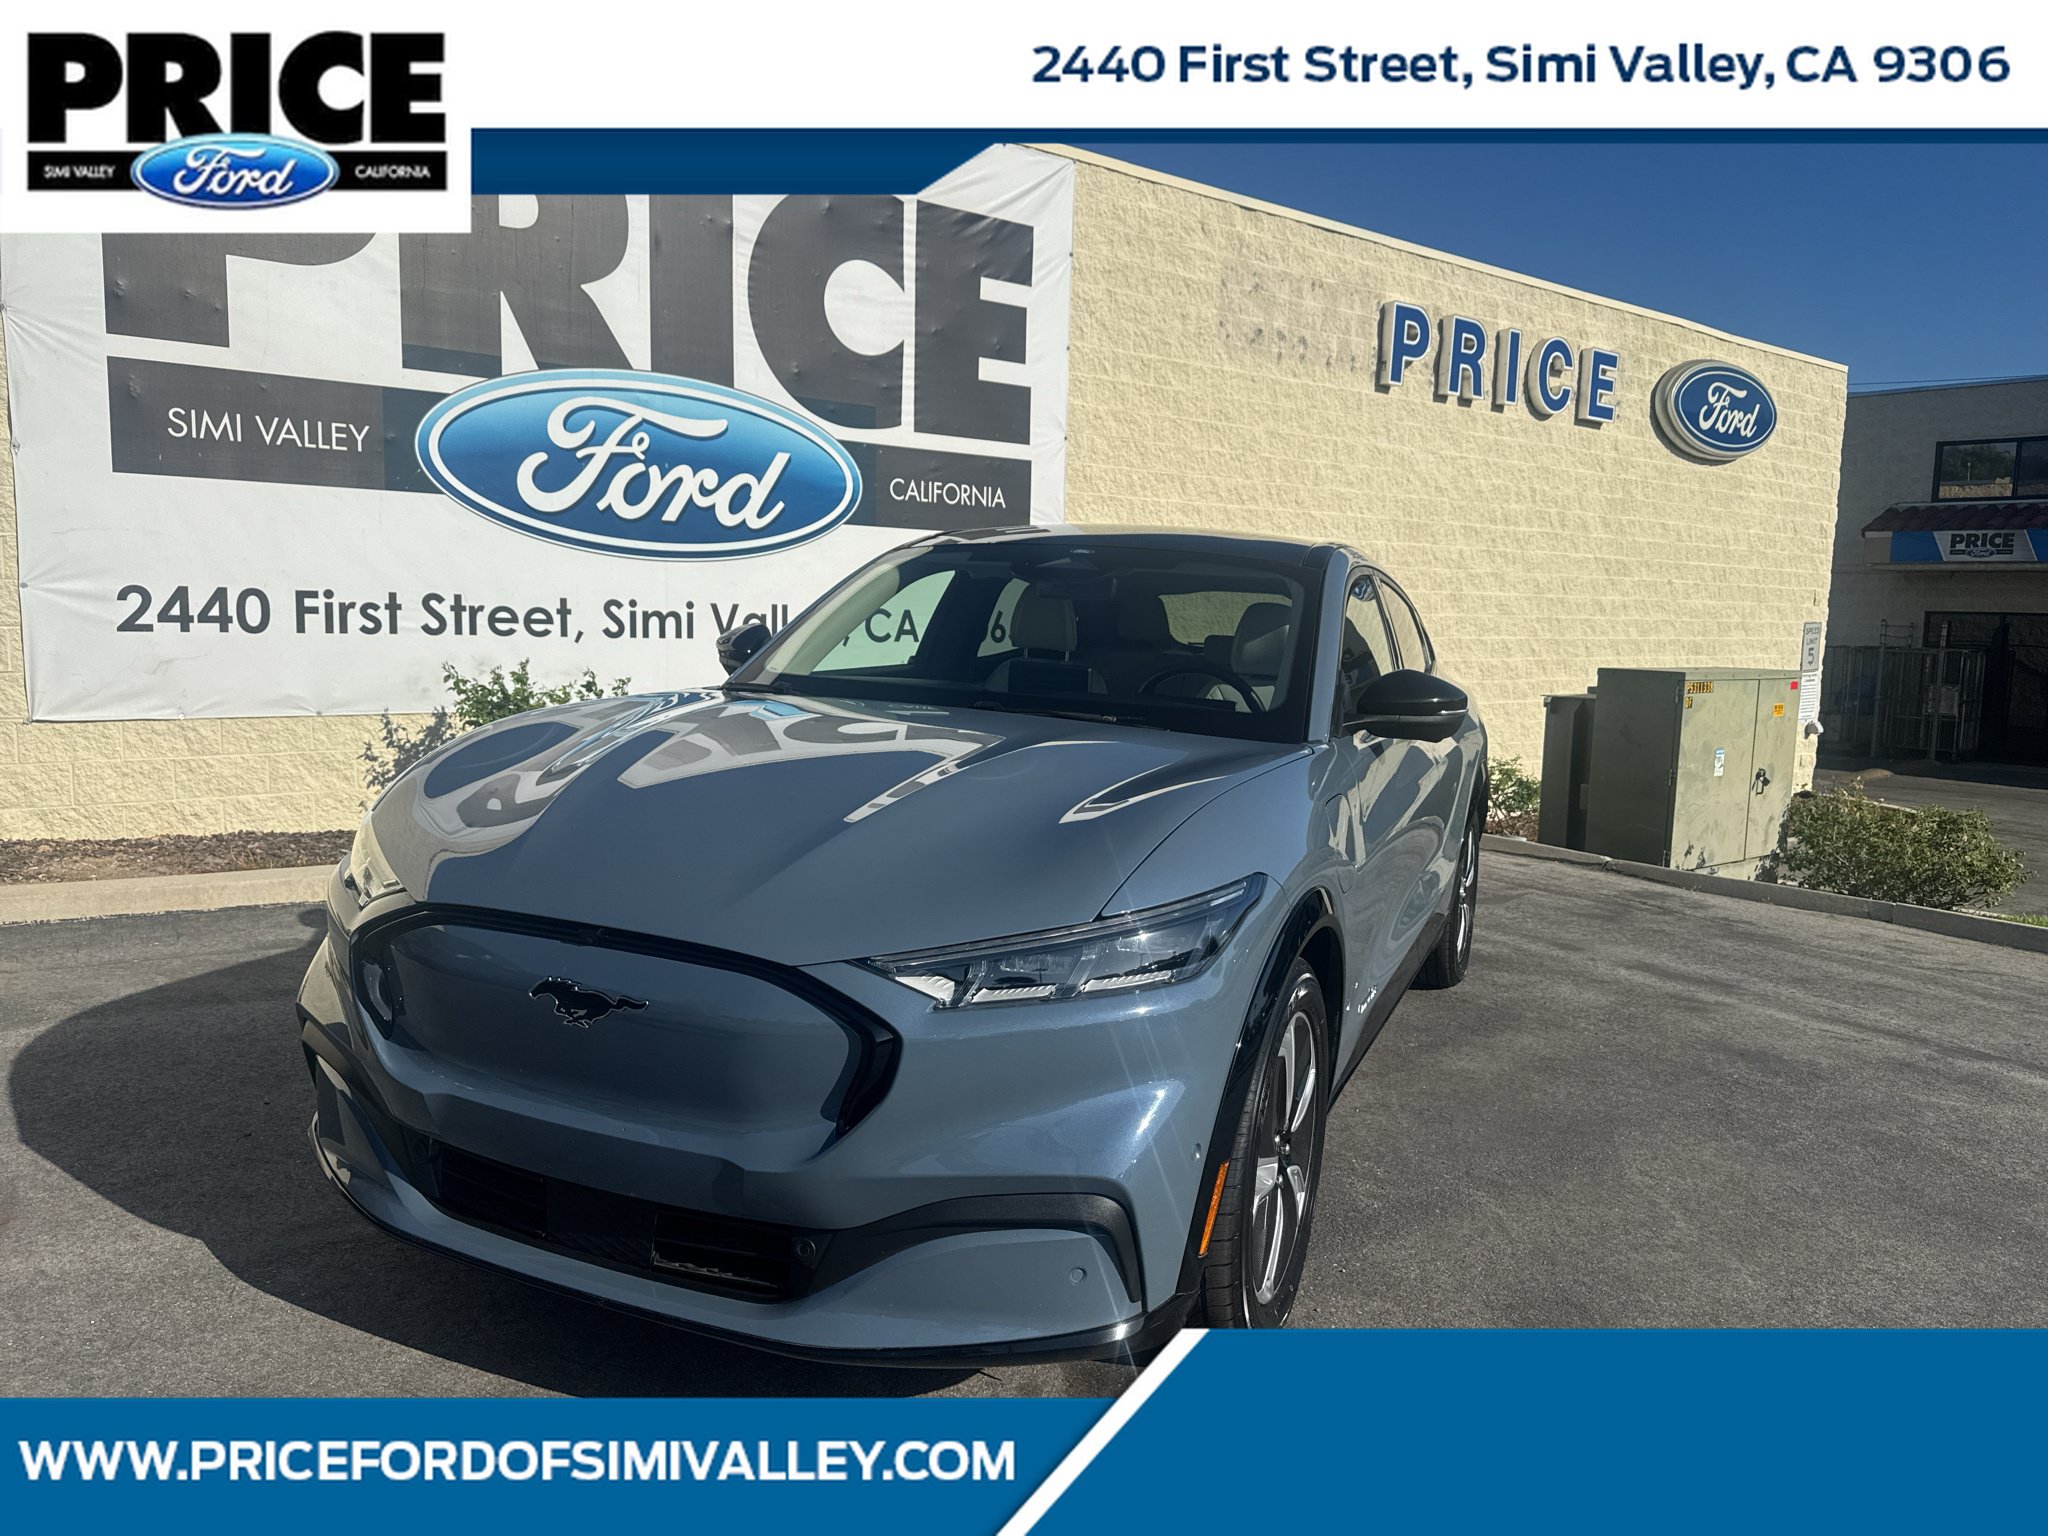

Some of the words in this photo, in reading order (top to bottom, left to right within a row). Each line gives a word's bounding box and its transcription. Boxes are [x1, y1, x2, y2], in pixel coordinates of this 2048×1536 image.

[1380, 300, 1620, 423] PRICE
[166, 407, 242, 444] SIMI
[255, 415, 370, 453] VALLEY
[1698, 381, 1761, 439] Ford
[516, 396, 791, 530] Ford
[889, 477, 1006, 509] CALIFORNIA
[1950, 532, 2016, 548] PRICE
[116, 584, 271, 634] 2440
[295, 590, 402, 635] First
[420, 593, 584, 644] Street,
[603, 598, 695, 640] Simi
[1804, 626, 1820, 635] SPEED
[1807, 646, 1815, 666] 5
